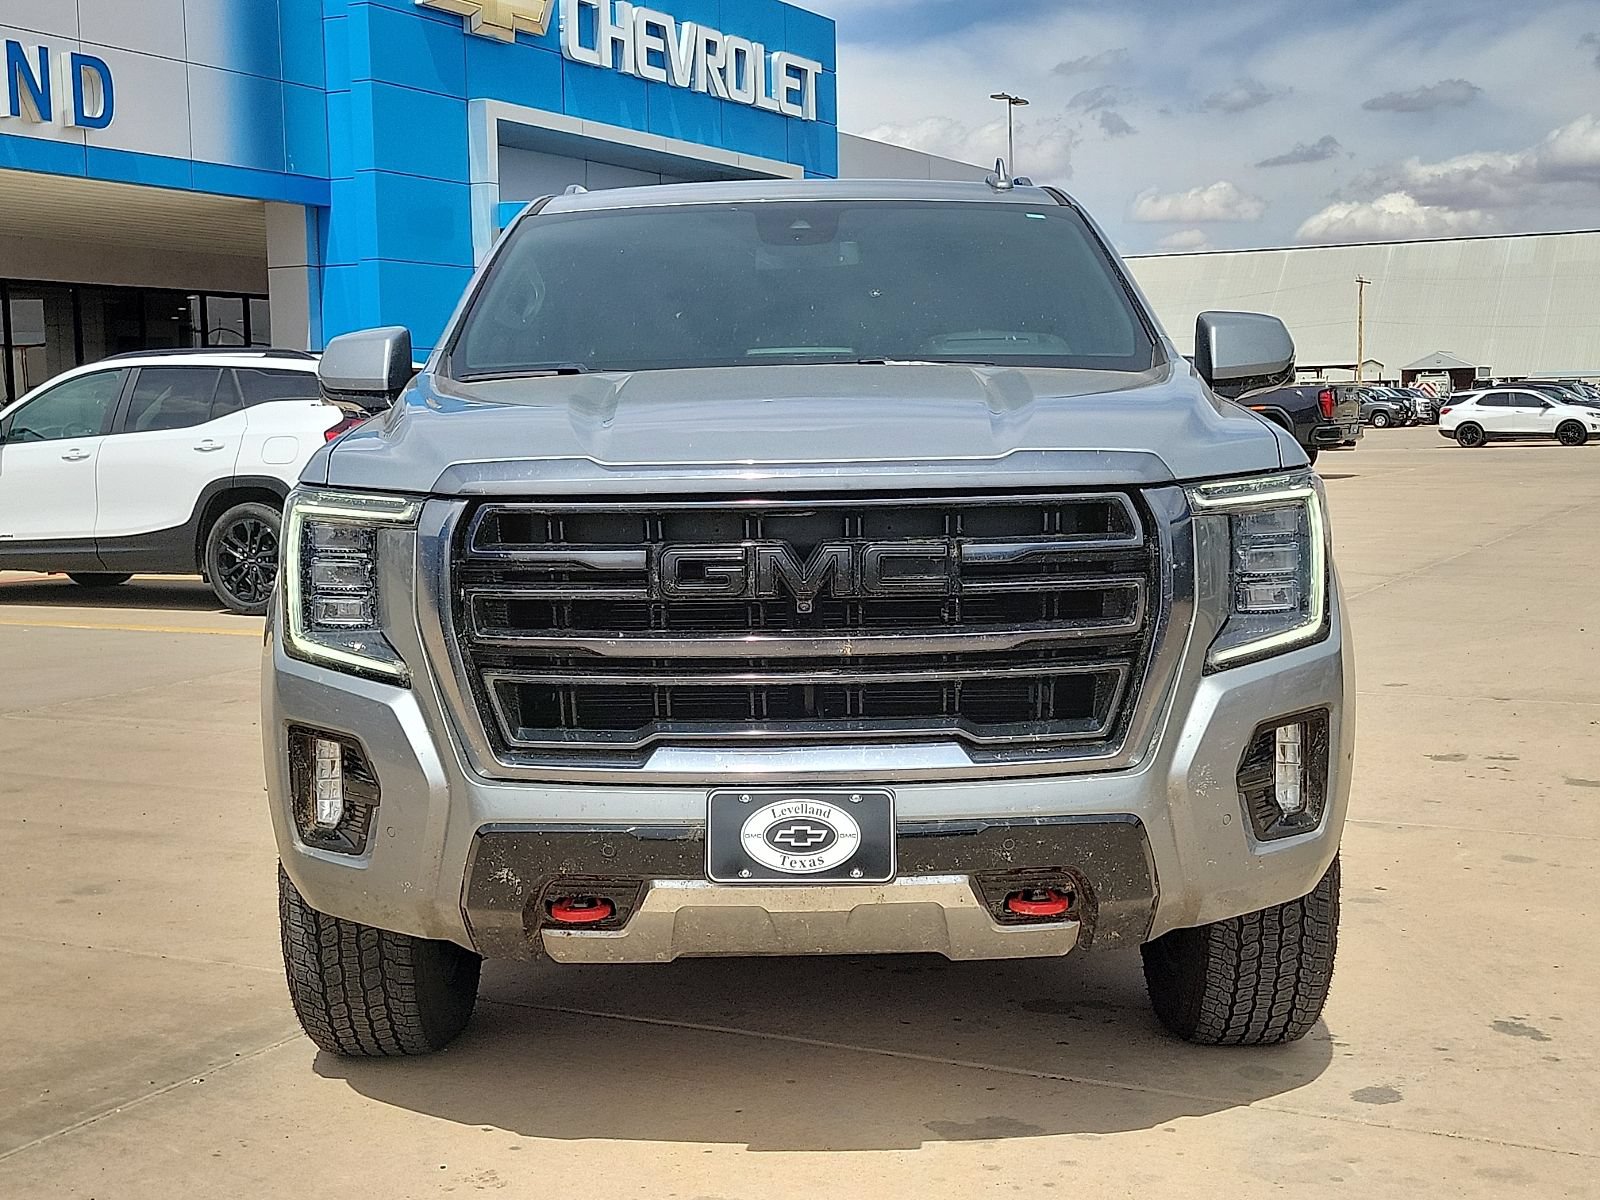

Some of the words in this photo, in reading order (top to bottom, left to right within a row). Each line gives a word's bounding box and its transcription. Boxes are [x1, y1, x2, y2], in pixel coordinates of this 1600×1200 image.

[561, 0, 822, 121] CHEVROLET
[660, 543, 950, 599] GMC
[771, 804, 832, 819] Levelland
[780, 854, 825, 869] Texas
